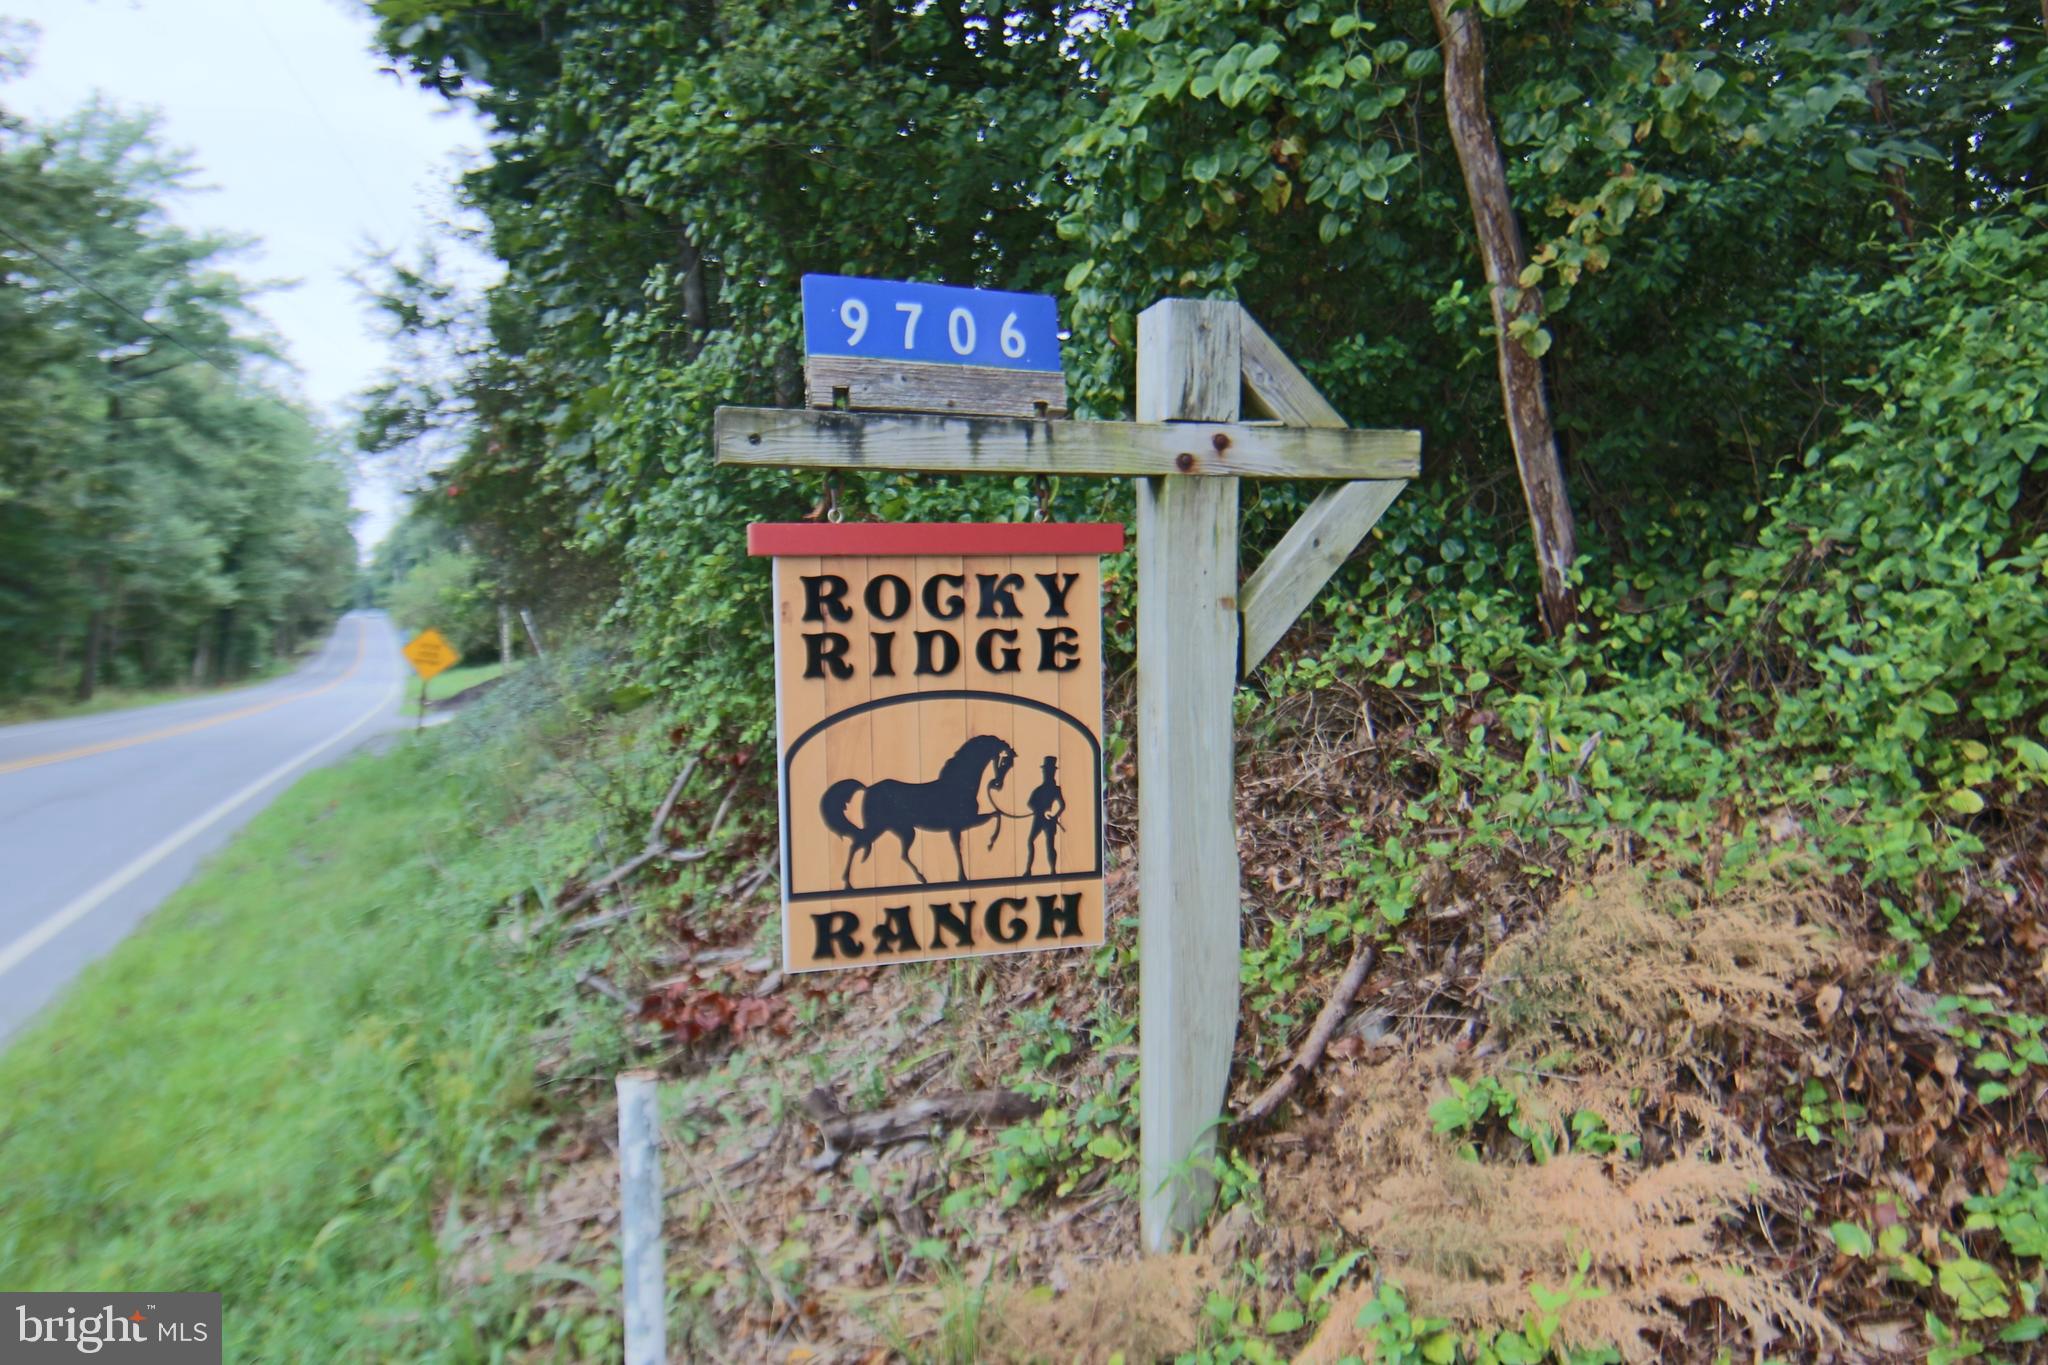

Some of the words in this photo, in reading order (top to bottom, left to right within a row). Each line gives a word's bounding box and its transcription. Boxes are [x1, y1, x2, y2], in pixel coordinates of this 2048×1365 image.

[840, 299, 1026, 358] 9706
[800, 573, 1079, 623] ROCKY
[801, 626, 1081, 681] RIDGE
[811, 892, 1084, 960] RANCH
